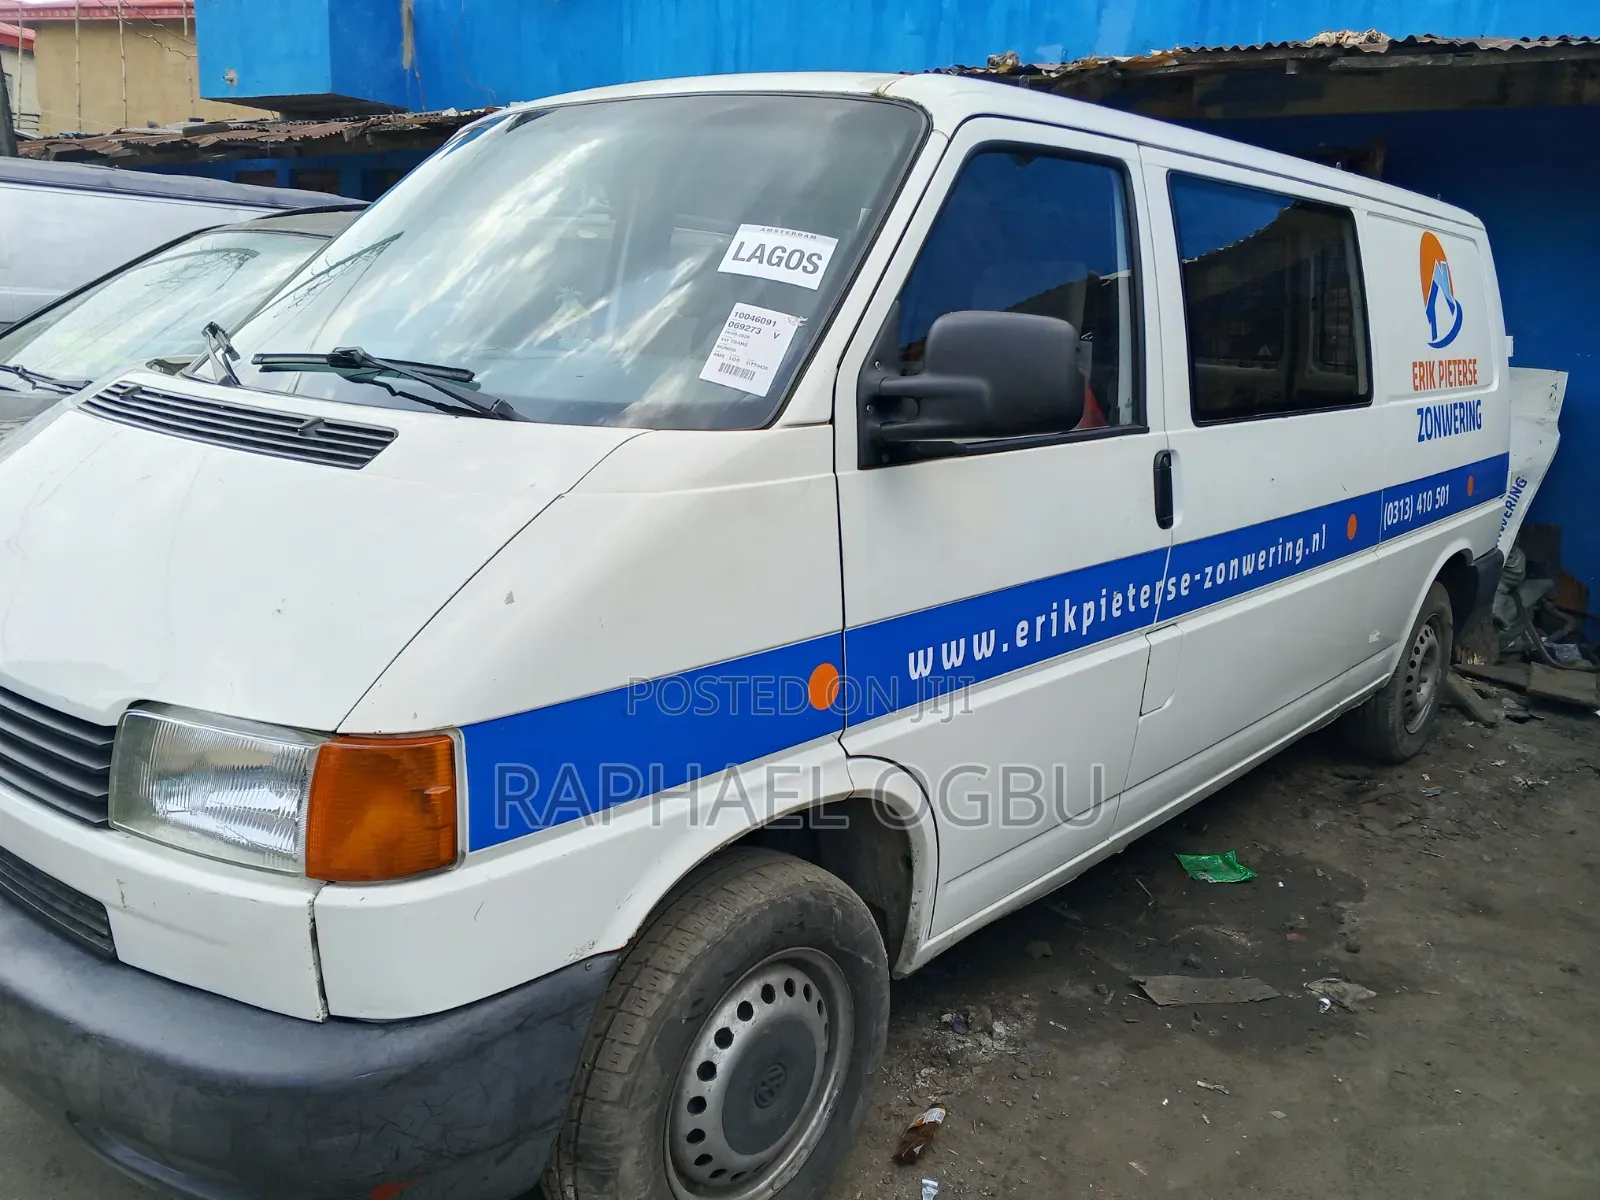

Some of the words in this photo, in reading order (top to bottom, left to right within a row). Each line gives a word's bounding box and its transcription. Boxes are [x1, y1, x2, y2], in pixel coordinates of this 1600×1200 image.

[760, 227, 817, 240] AMSTERDAM
[731, 241, 823, 275] LAGOS
[727, 320, 762, 335] 069273
[734, 311, 777, 328] 10046091
[773, 331, 780, 340] V
[1412, 360, 1436, 391] ERIK
[1438, 358, 1478, 388] PIETERSE
[1416, 399, 1482, 442] ZONWERING
[1383, 495, 1413, 531] (0313)
[1416, 490, 1433, 514] 410
[1435, 484, 1450, 508] 501
[908, 524, 1327, 680] www.erikpieterse-zonwering.nl
